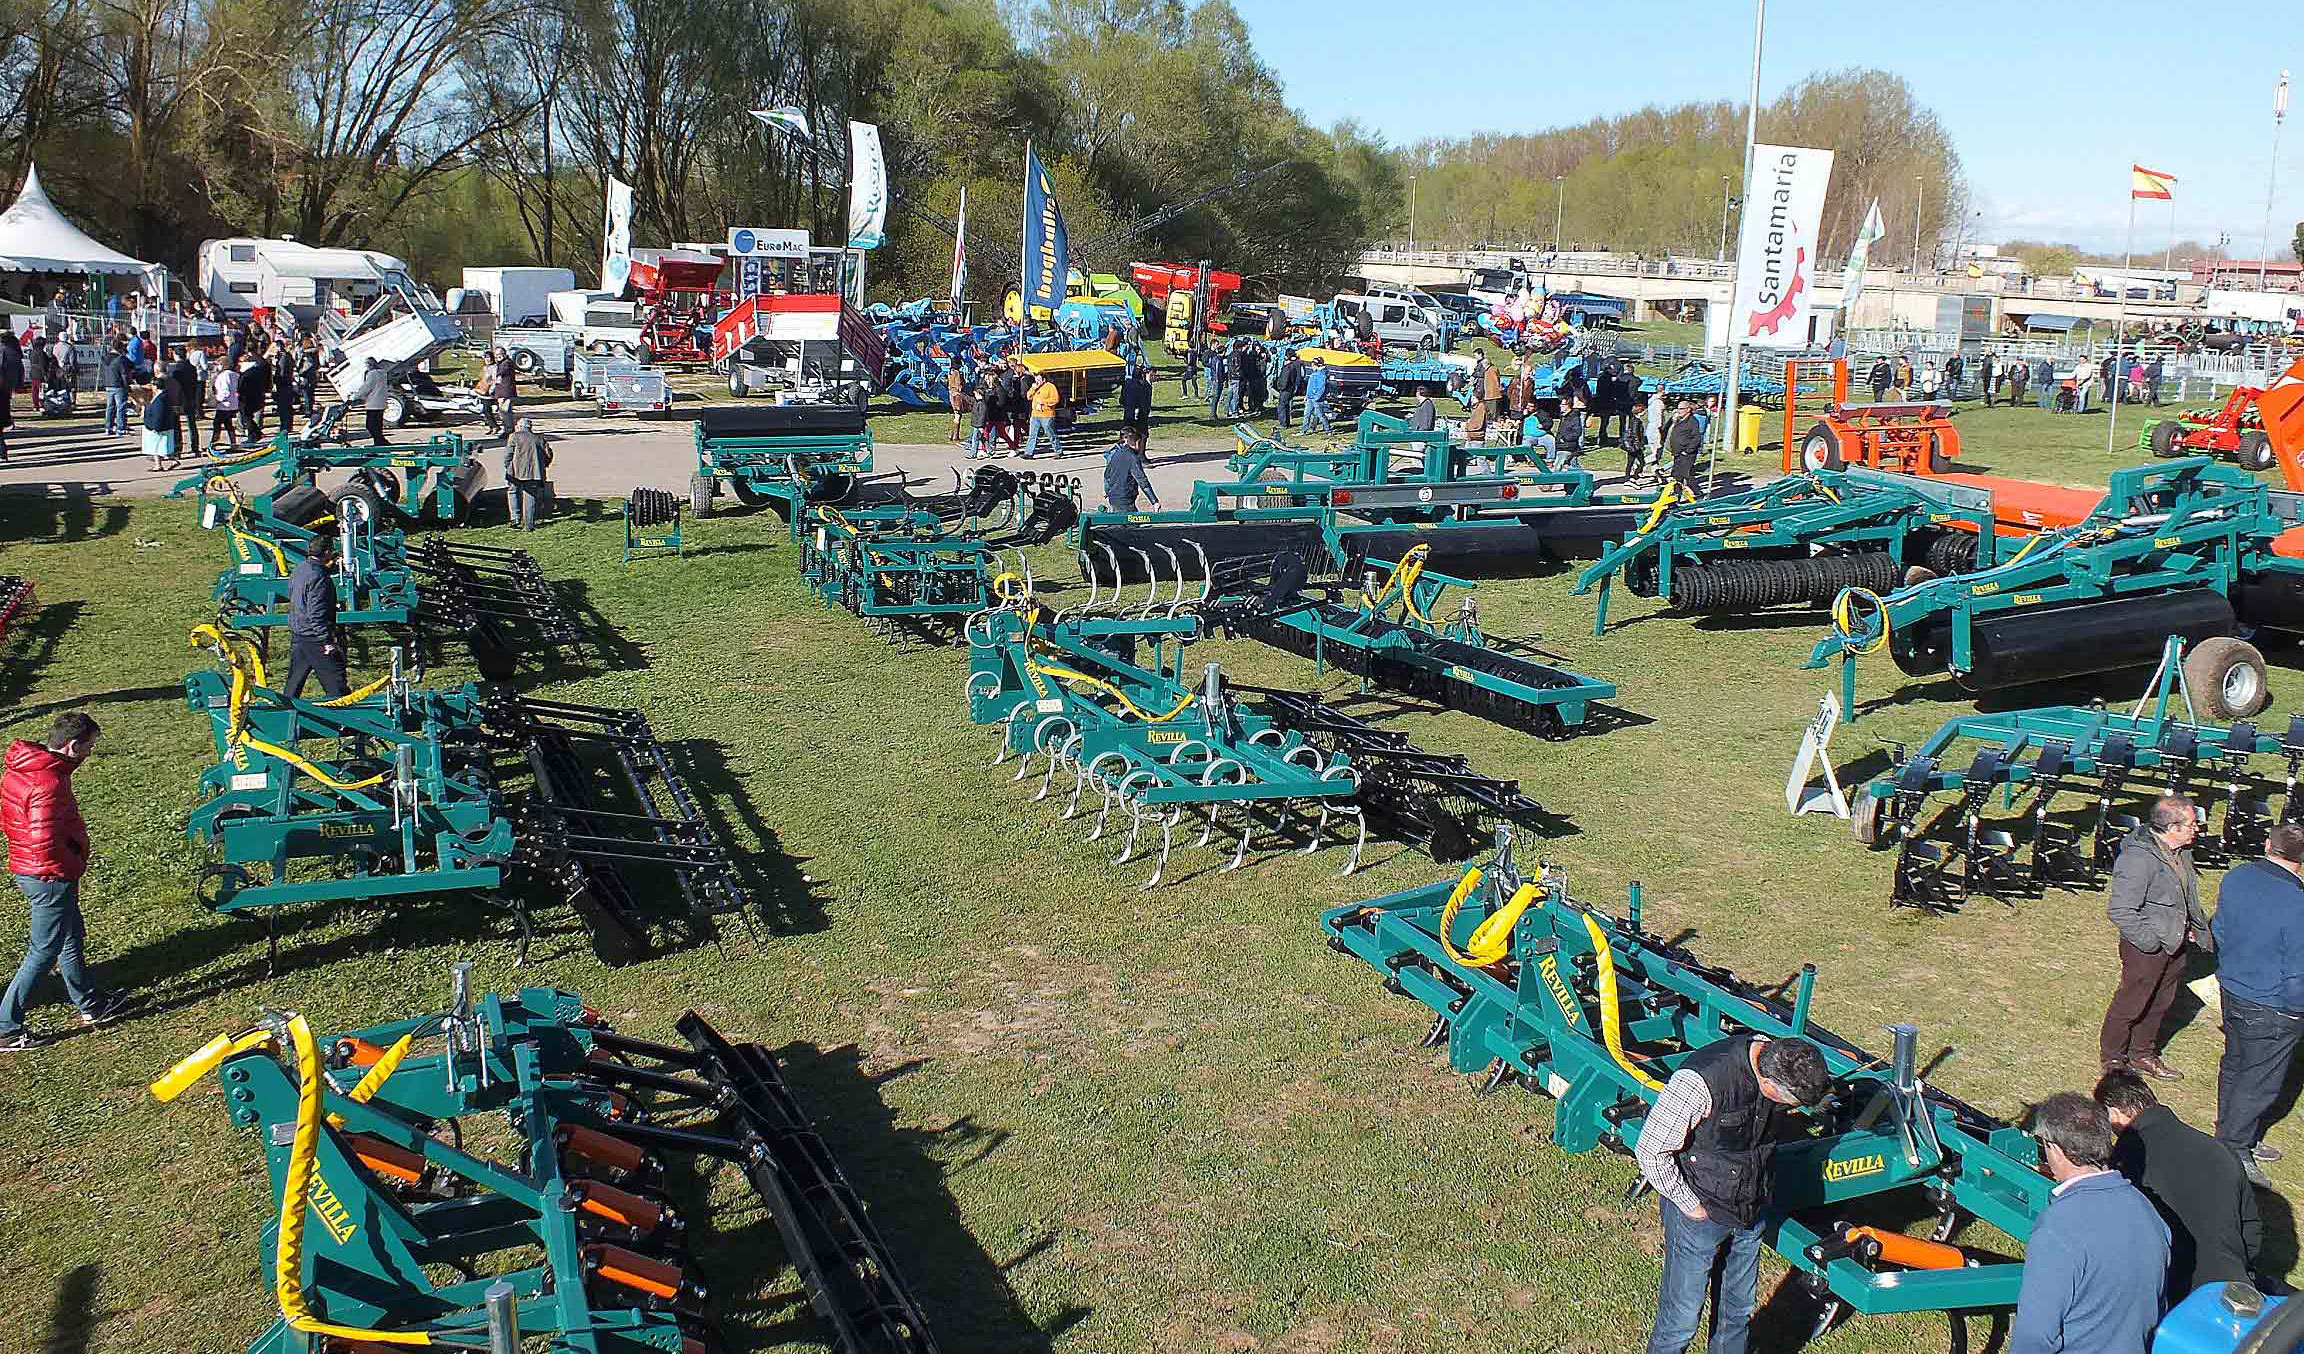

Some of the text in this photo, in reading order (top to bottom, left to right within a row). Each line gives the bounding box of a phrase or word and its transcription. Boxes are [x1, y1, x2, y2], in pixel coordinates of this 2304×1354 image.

[1036, 197, 1057, 299] bogballe
[1758, 153, 1798, 305] Santamaria
[1146, 729, 1187, 744] REVILLA
[319, 823, 376, 839] REVILLA
[1538, 954, 1582, 1028] REVILLA
[303, 1156, 358, 1245] EVILLA
[1823, 1153, 1886, 1182] REVILLA
